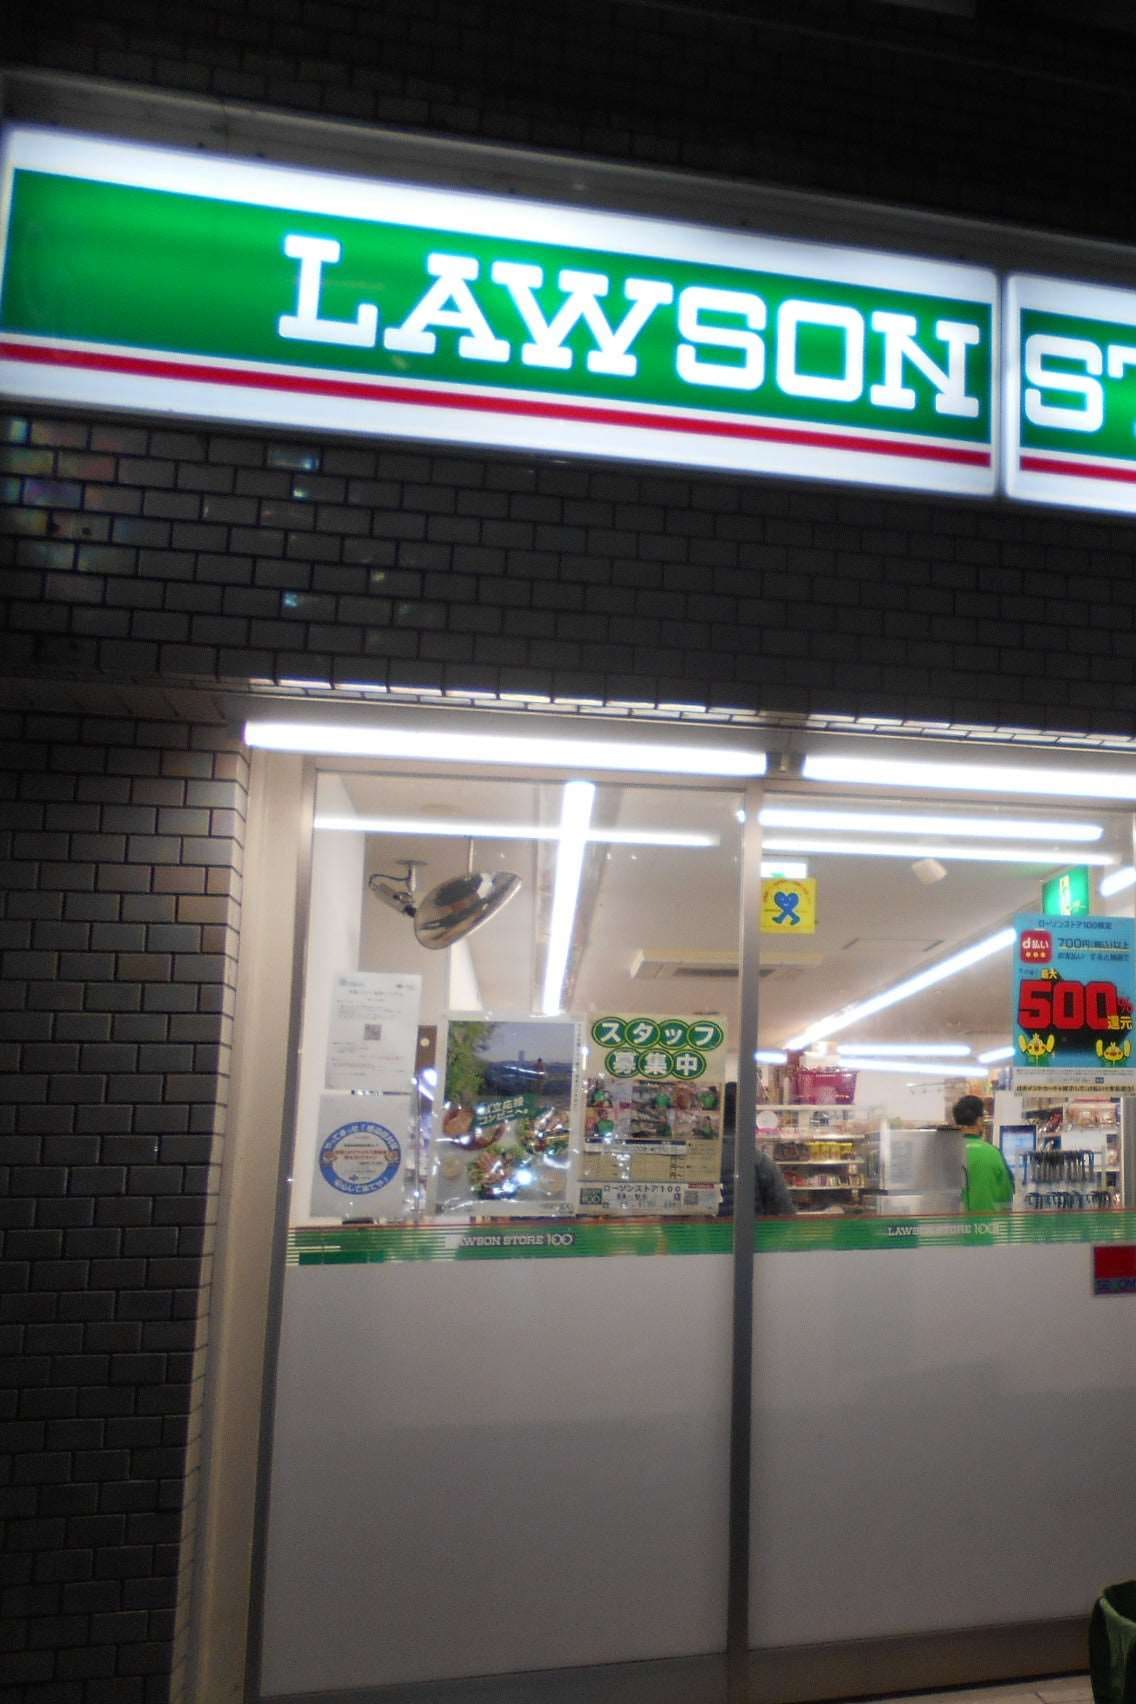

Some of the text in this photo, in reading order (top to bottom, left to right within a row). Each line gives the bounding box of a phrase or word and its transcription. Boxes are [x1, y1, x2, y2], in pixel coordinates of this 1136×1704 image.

[278, 233, 981, 418] LAWSON
[1022, 936, 1049, 949] d払い
[600, 1021, 715, 1046] スタッフ
[612, 1051, 699, 1077] 募集中
[456, 1233, 574, 1247] AWSON STORE 100
